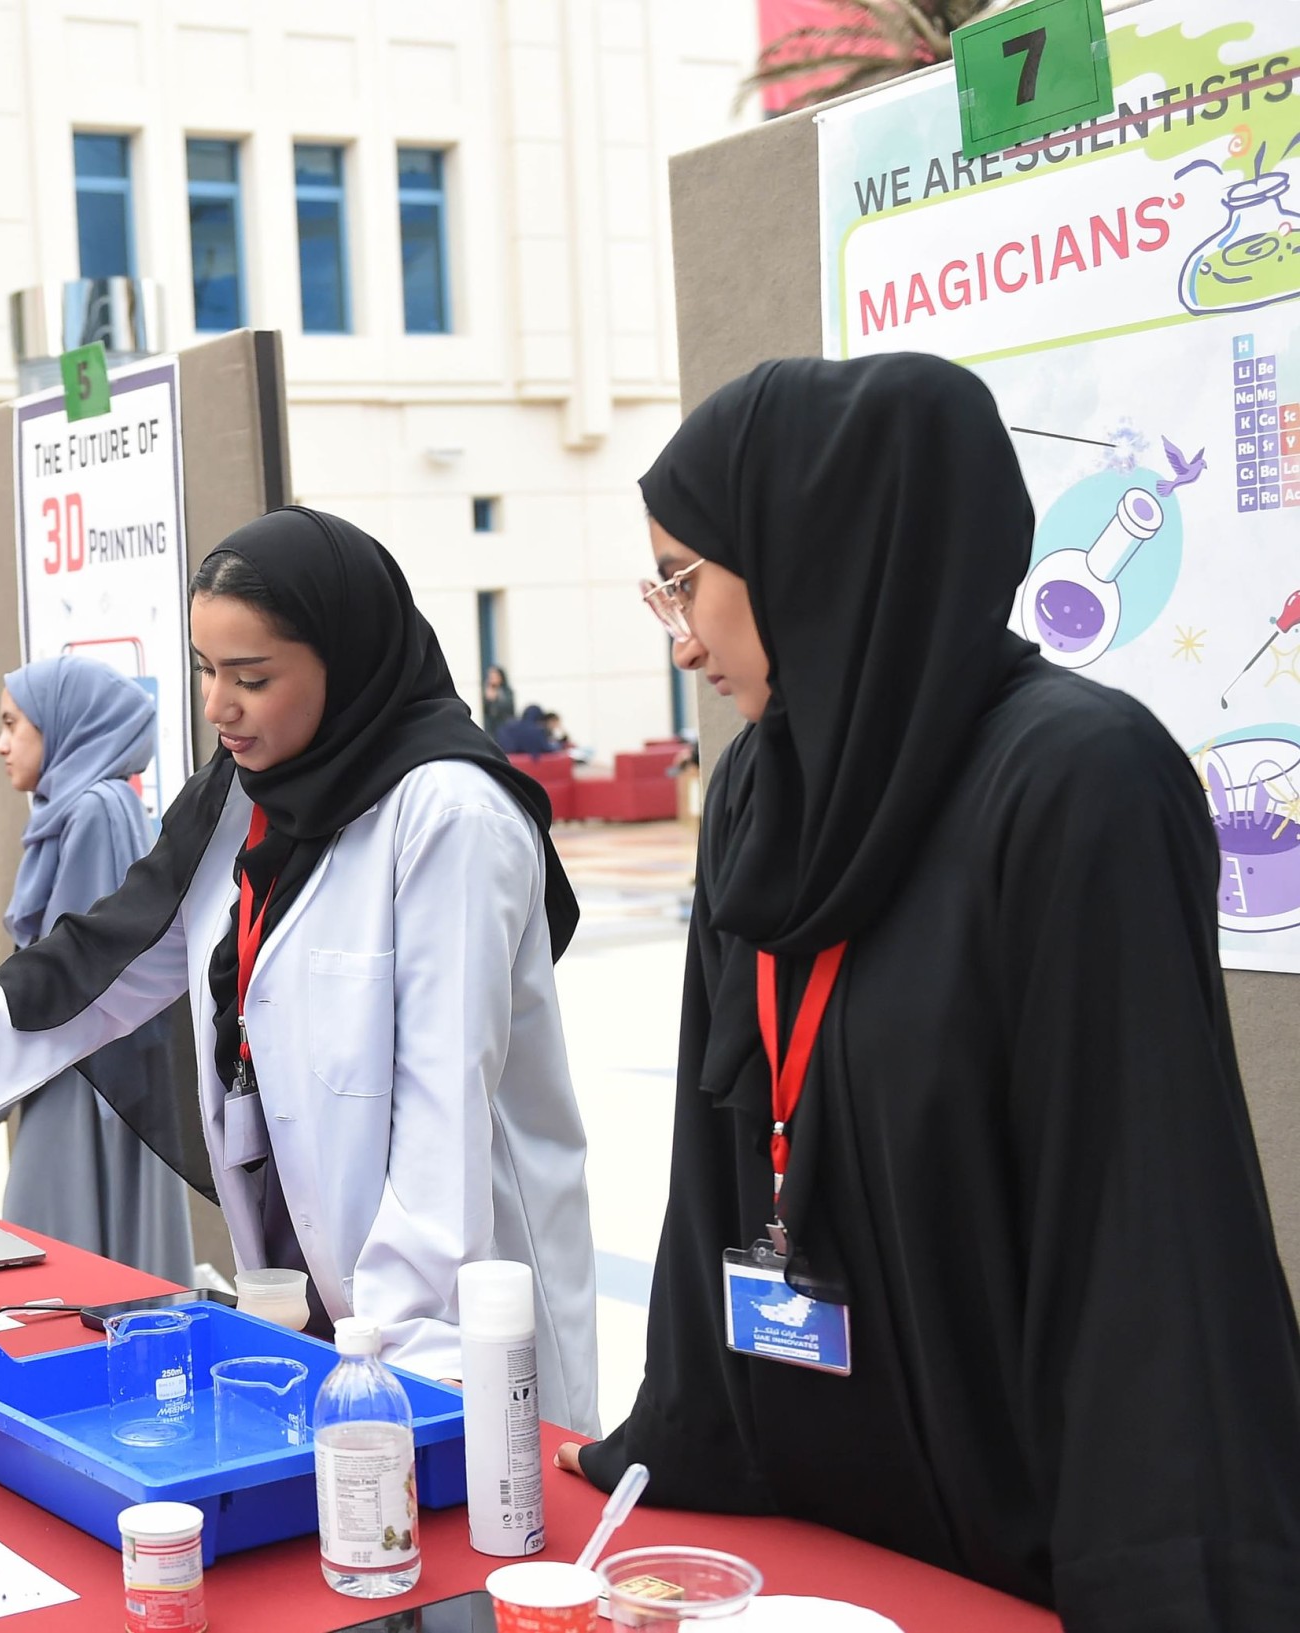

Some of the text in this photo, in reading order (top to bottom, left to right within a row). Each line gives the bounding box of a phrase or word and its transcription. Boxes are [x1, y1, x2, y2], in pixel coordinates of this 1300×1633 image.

[1001, 27, 1047, 106] 7
[853, 166, 912, 217] WE
[922, 151, 1003, 200] ARE
[1238, 340, 1249, 353] H
[76, 360, 92, 400] 5
[1238, 362, 1274, 379] Li Be
[1236, 387, 1276, 405] Na Mg
[1240, 410, 1297, 430] K Ca Sc
[35, 419, 159, 478] THE FUTURE OF
[1237, 435, 1296, 455] Rb Sr Y
[1240, 467, 1254, 480] Cs
[1260, 465, 1278, 478] Ba
[1241, 493, 1255, 506] Fr
[1261, 491, 1279, 504] Ra
[42, 493, 166, 575] 3D PRINTING
[753, 1333, 820, 1350] UAE INNOVATES
